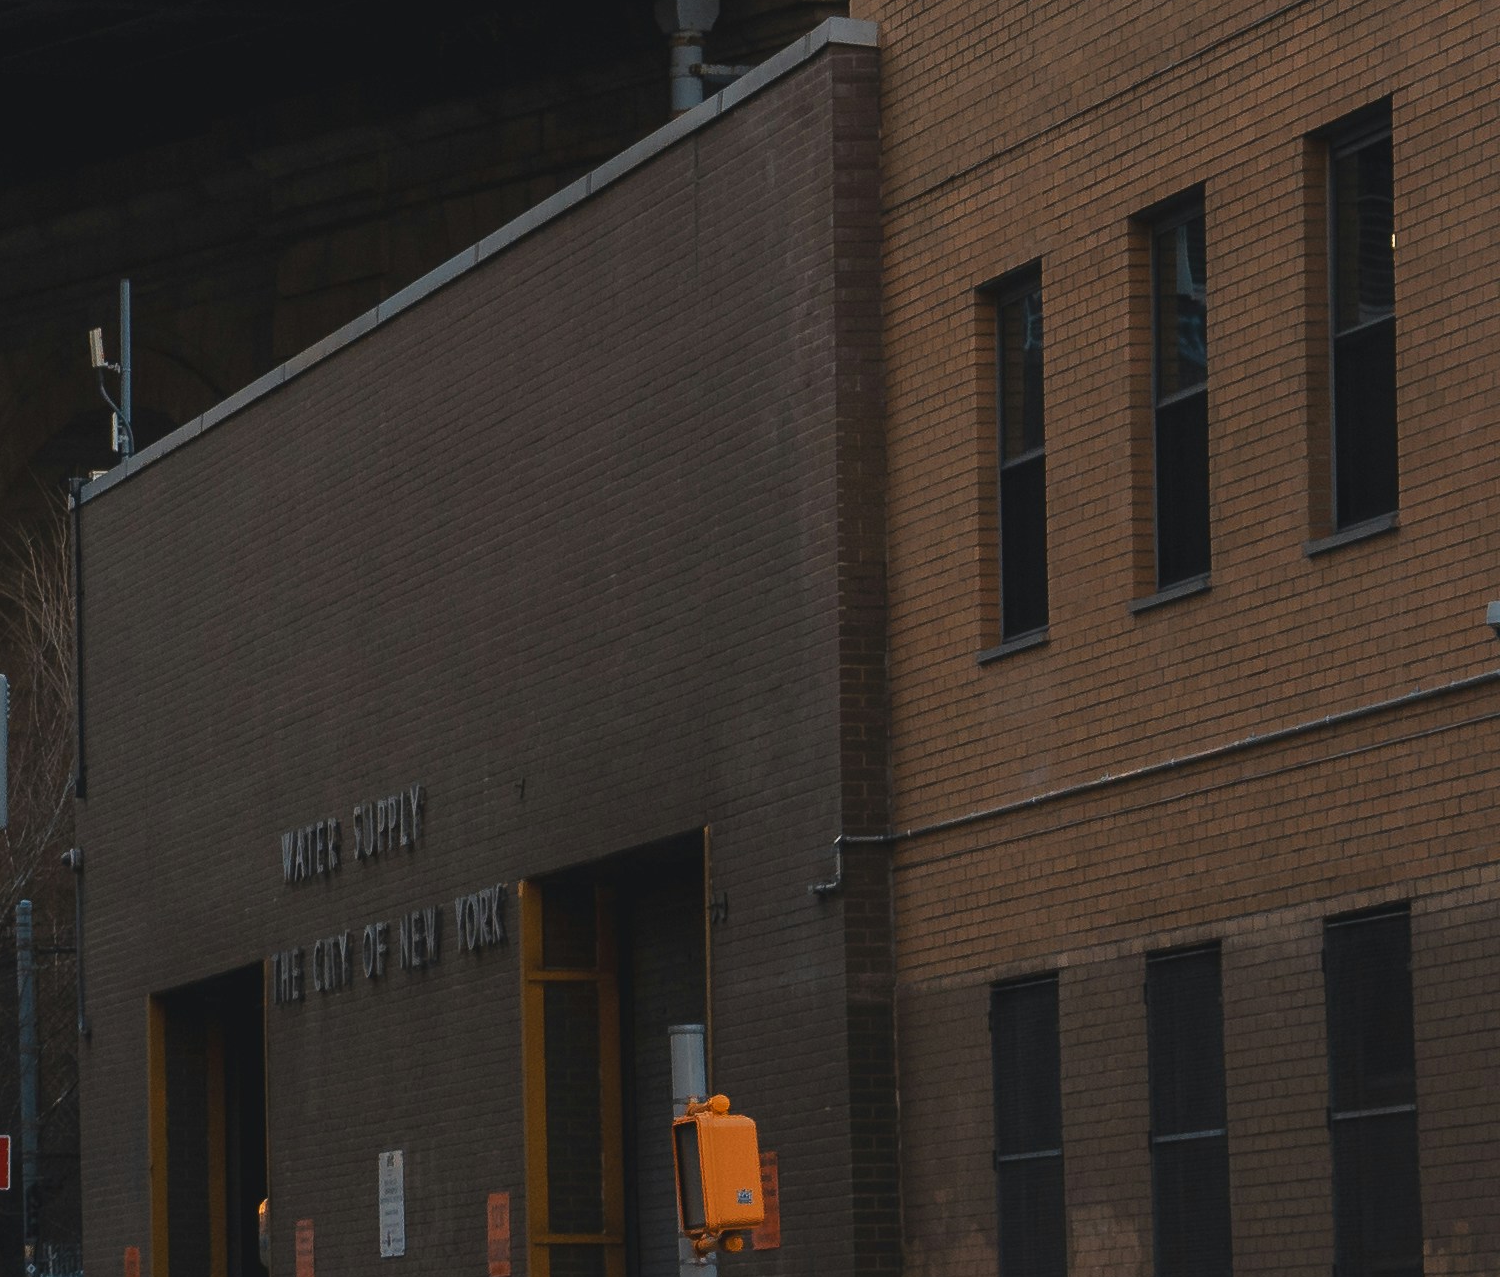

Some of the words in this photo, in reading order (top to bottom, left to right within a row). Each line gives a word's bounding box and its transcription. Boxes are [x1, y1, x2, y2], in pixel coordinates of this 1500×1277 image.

[281, 818, 338, 882] WATER
[353, 784, 422, 860] SUPPLY
[271, 947, 300, 1004] THE
[313, 929, 349, 992] CITY
[363, 922, 388, 978] OF
[400, 906, 436, 970] NEW
[455, 882, 502, 953] YORK
